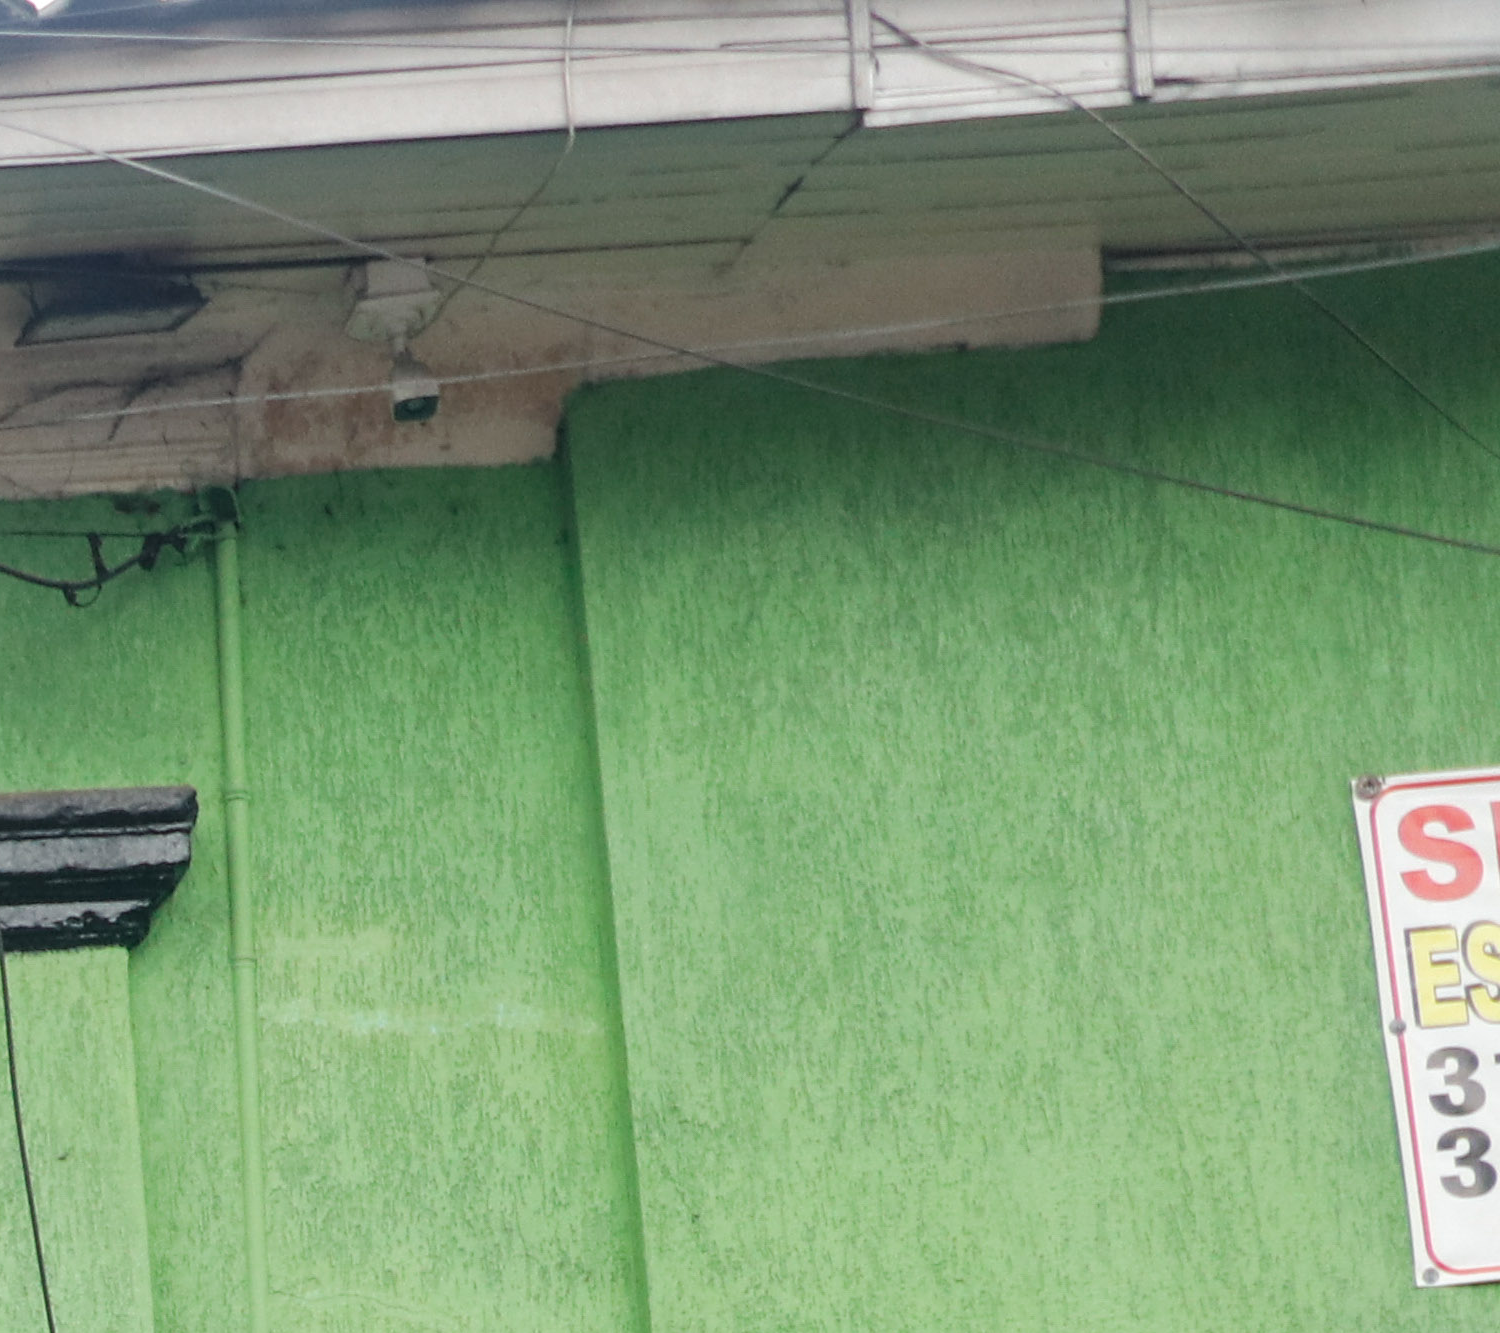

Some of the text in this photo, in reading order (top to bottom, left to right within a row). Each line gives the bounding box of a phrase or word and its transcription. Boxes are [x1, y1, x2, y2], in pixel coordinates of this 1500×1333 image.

[1397, 801, 1500, 902] S
[1426, 1046, 1500, 1117] 3
[1436, 1126, 1498, 1198] 3
